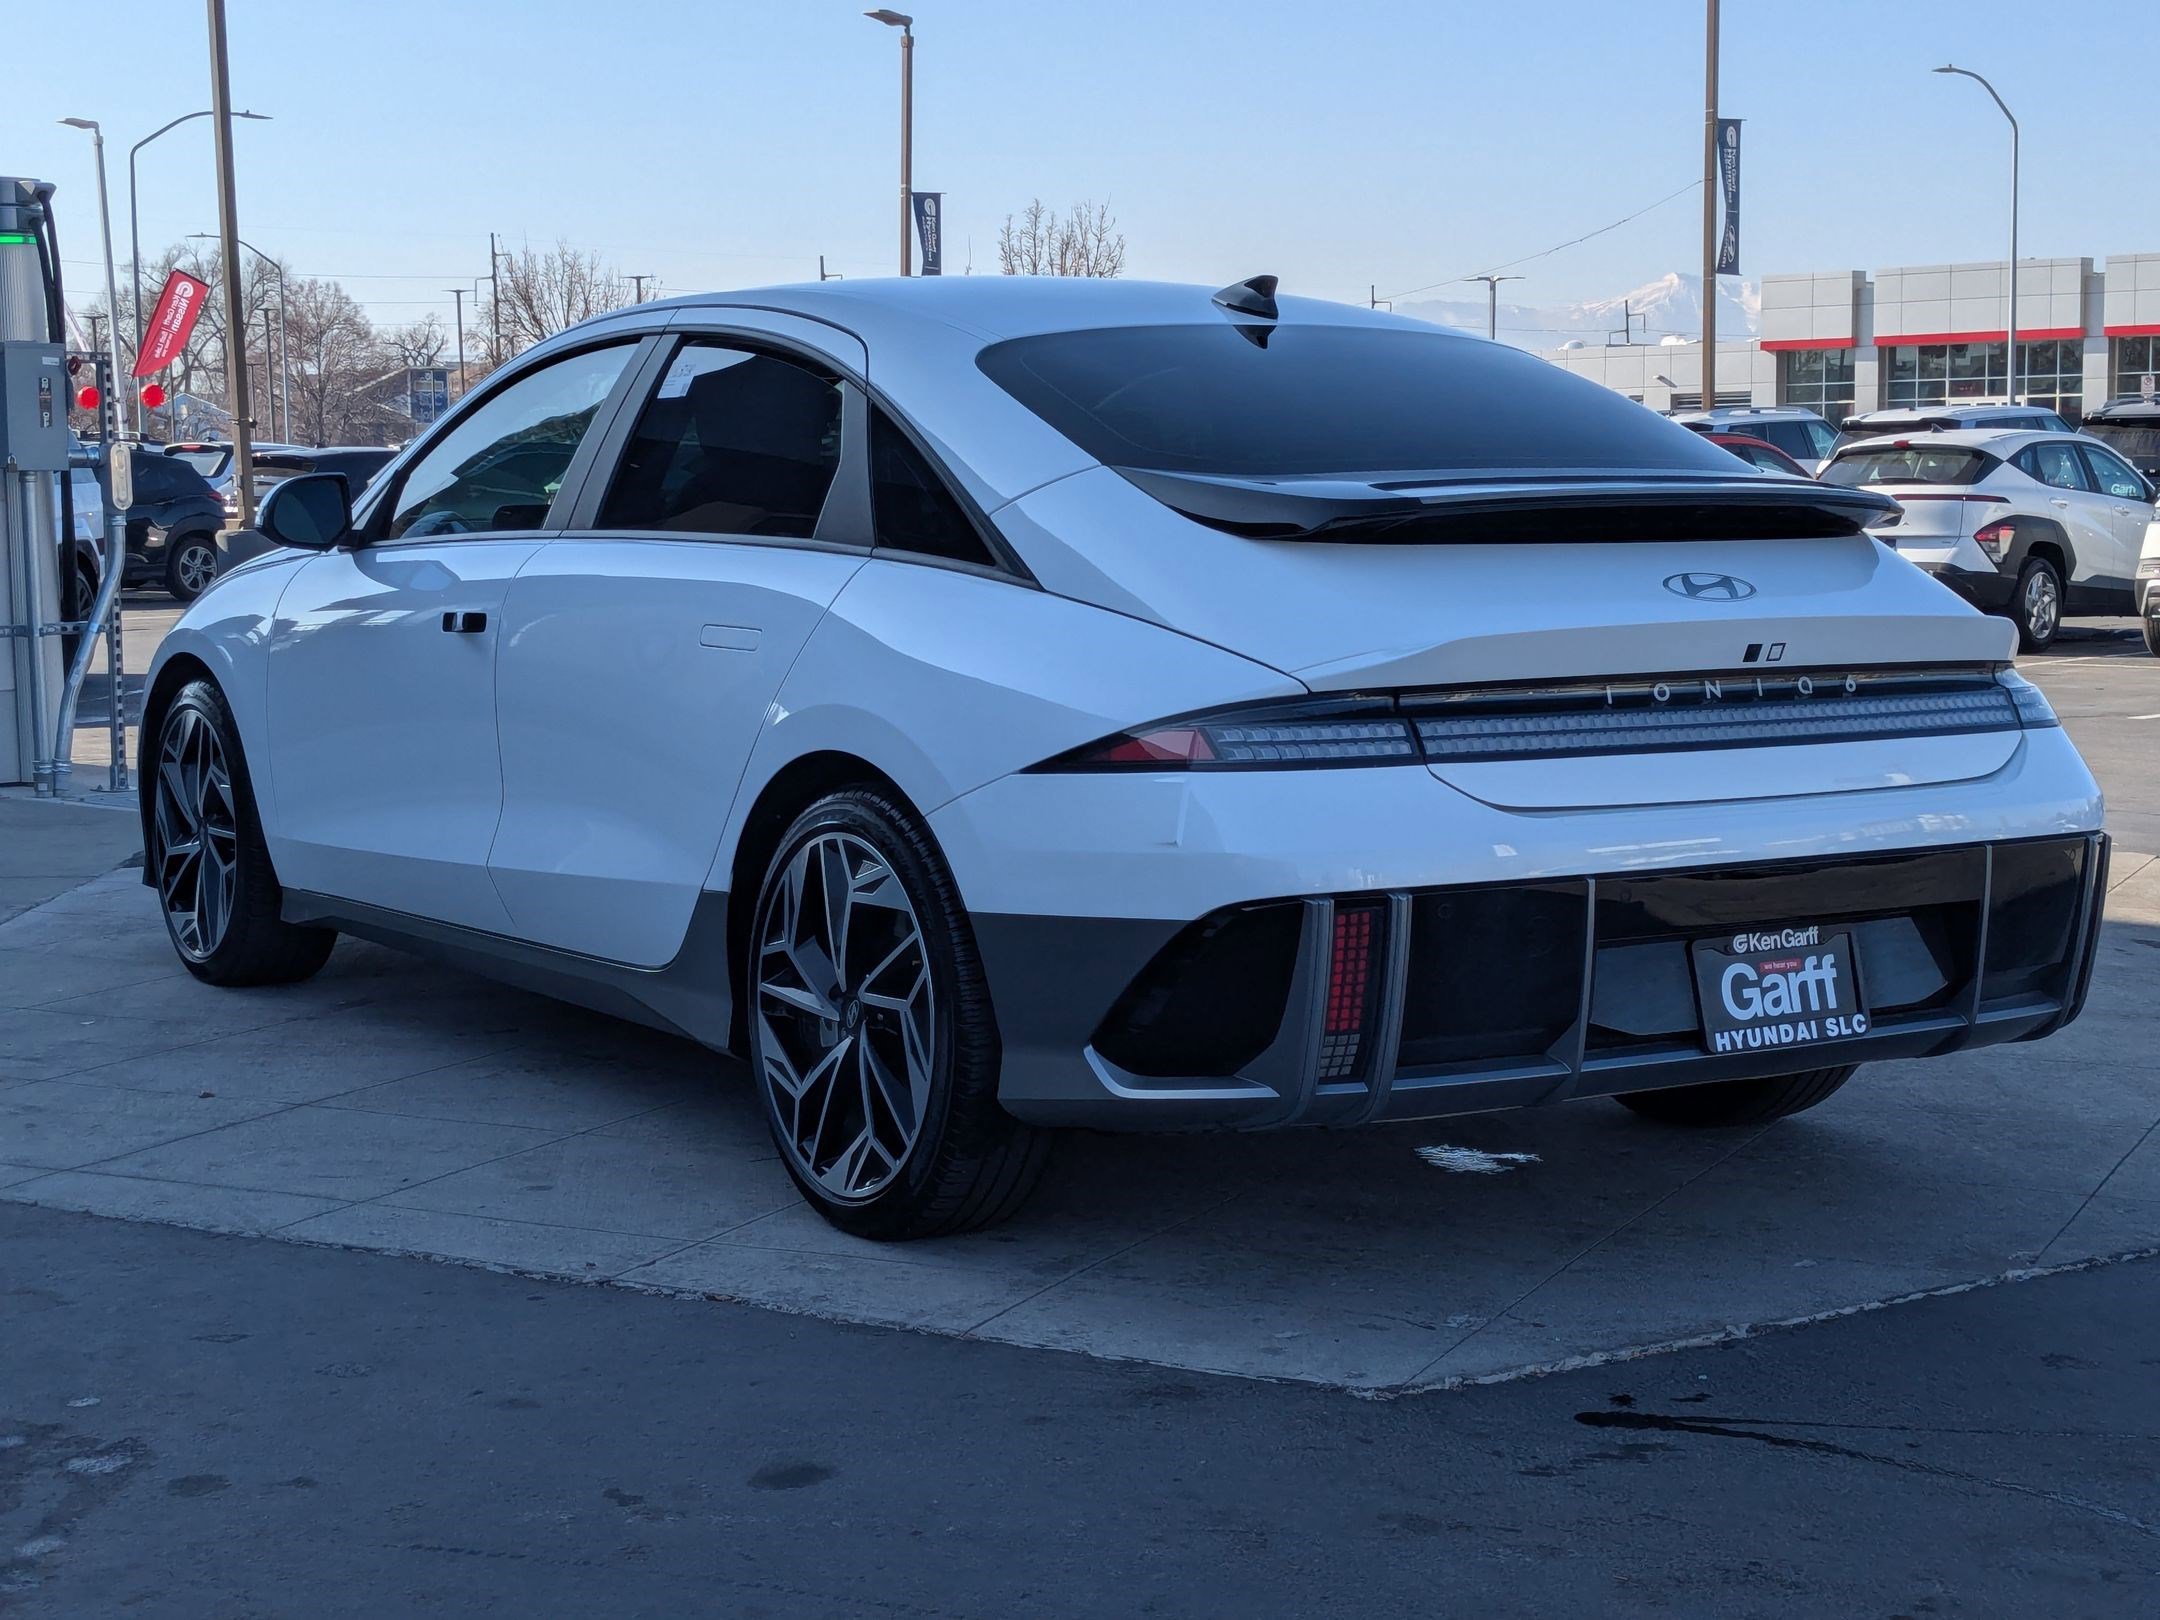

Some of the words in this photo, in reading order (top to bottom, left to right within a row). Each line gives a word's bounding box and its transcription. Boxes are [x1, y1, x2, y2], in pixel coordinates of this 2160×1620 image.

[1606, 676, 1813, 704] IONIQ
[1845, 674, 1856, 693] 6
[1721, 953, 1838, 1021] Garff
[1715, 1020, 1818, 1052] HYUNDAI
[1825, 1013, 1867, 1038] SLC
